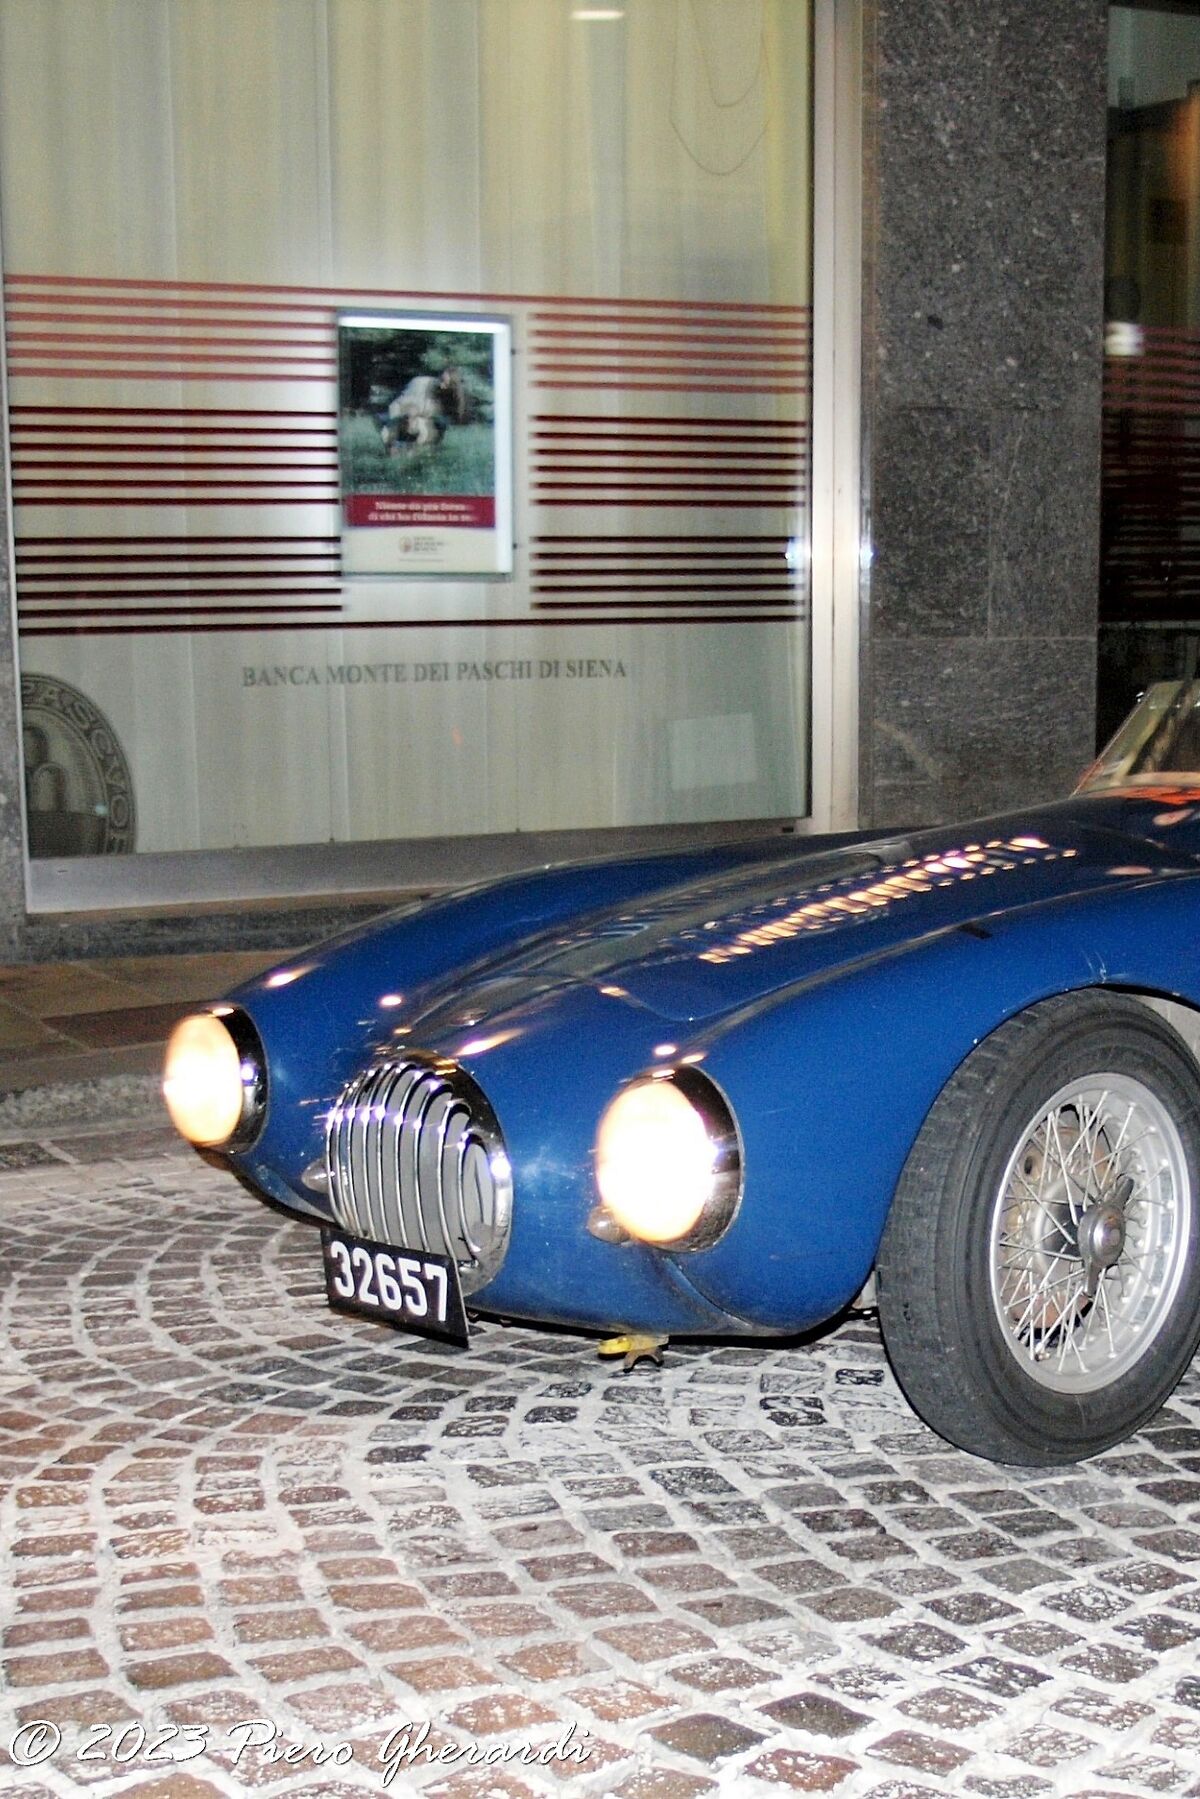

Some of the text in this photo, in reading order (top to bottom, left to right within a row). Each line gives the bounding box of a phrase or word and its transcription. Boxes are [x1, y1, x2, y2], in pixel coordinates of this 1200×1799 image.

[242, 658, 628, 688] BANCA MONTE DEI PASCHI DI SIENA
[330, 1240, 448, 1321] 32657
